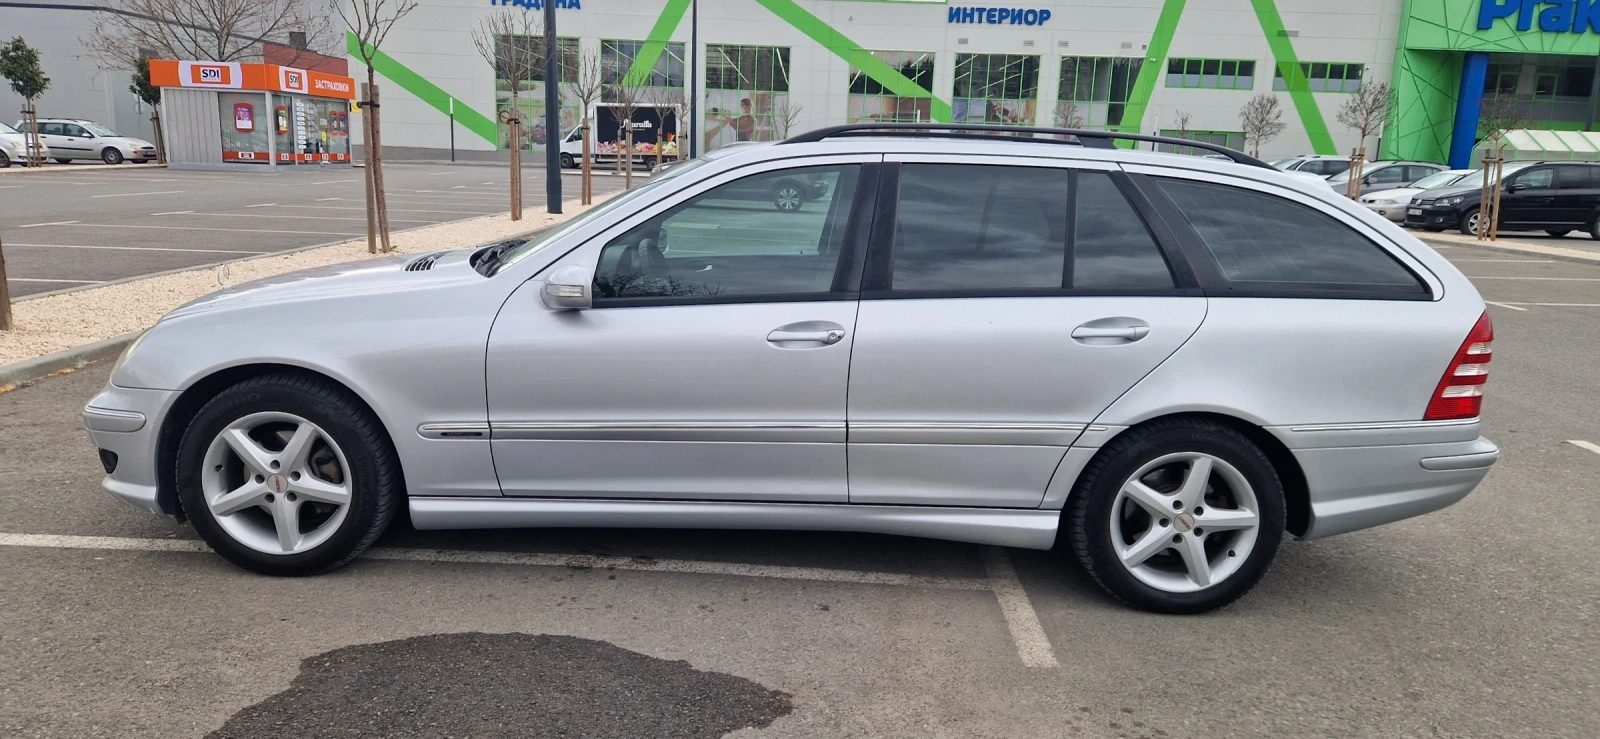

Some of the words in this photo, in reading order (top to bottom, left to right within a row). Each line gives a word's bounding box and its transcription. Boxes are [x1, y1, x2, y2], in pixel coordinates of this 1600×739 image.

[948, 7, 1052, 26] ИНТЕРИОР
[202, 69, 220, 78] SDI
[315, 79, 349, 92] ЗАСТРАХОВКИ
